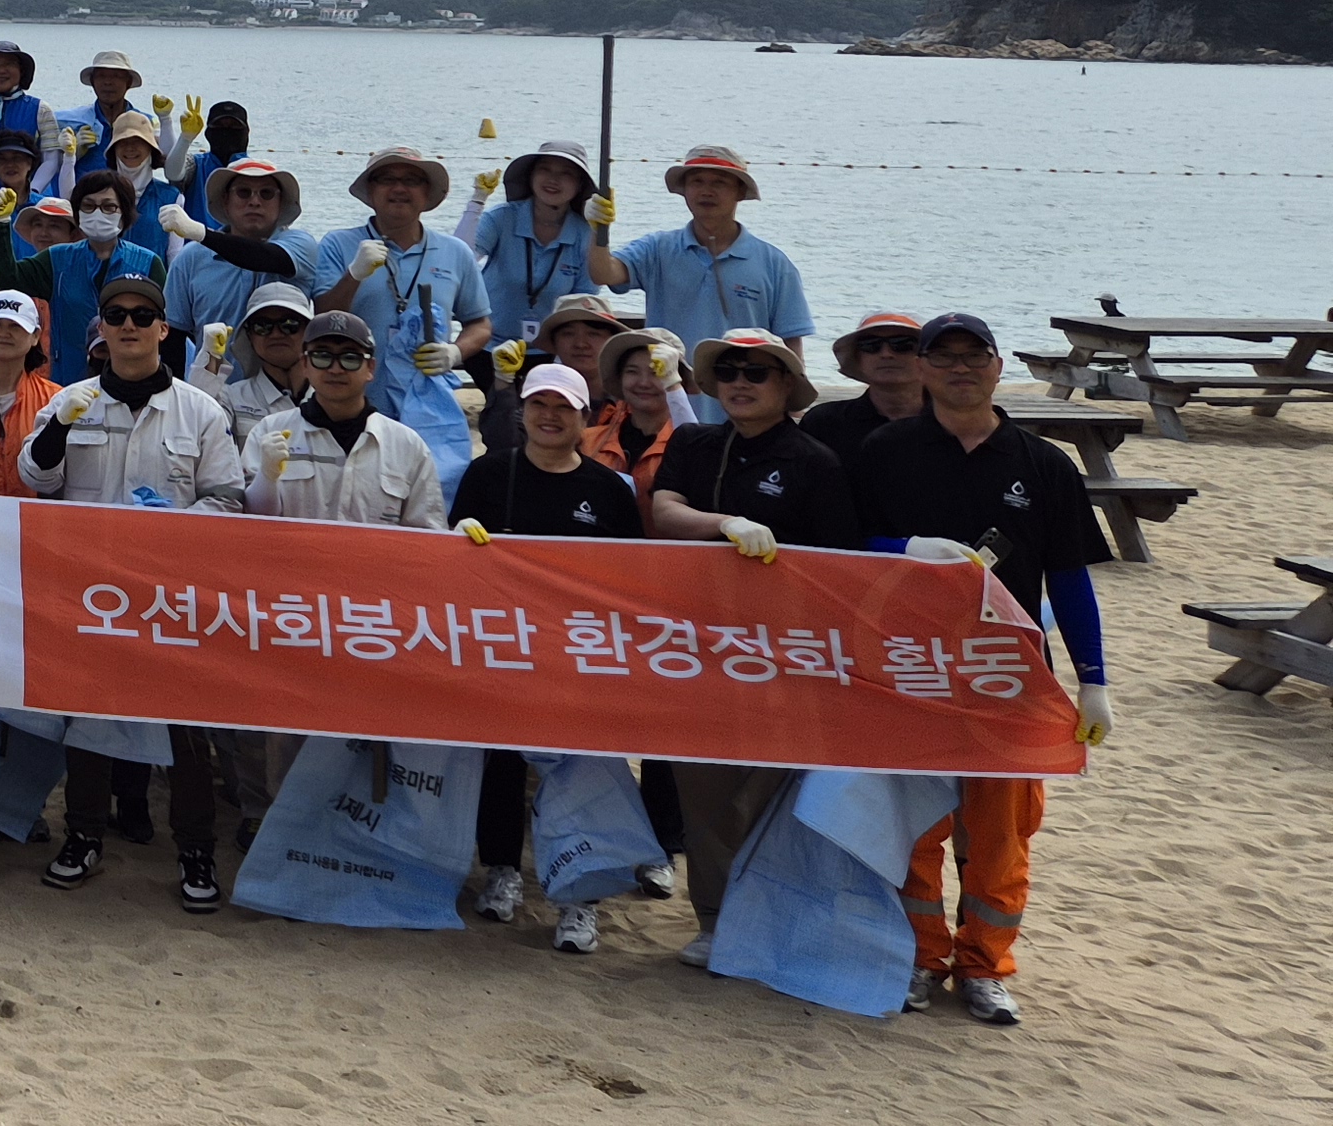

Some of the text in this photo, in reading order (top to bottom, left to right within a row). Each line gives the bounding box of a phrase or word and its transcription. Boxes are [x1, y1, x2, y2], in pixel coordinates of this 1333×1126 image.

[77, 582, 1031, 699] 오션사회봉사단 환경정화 활동
[391, 762, 445, 798] 용마대
[343, 860, 395, 882] 금지합니다
